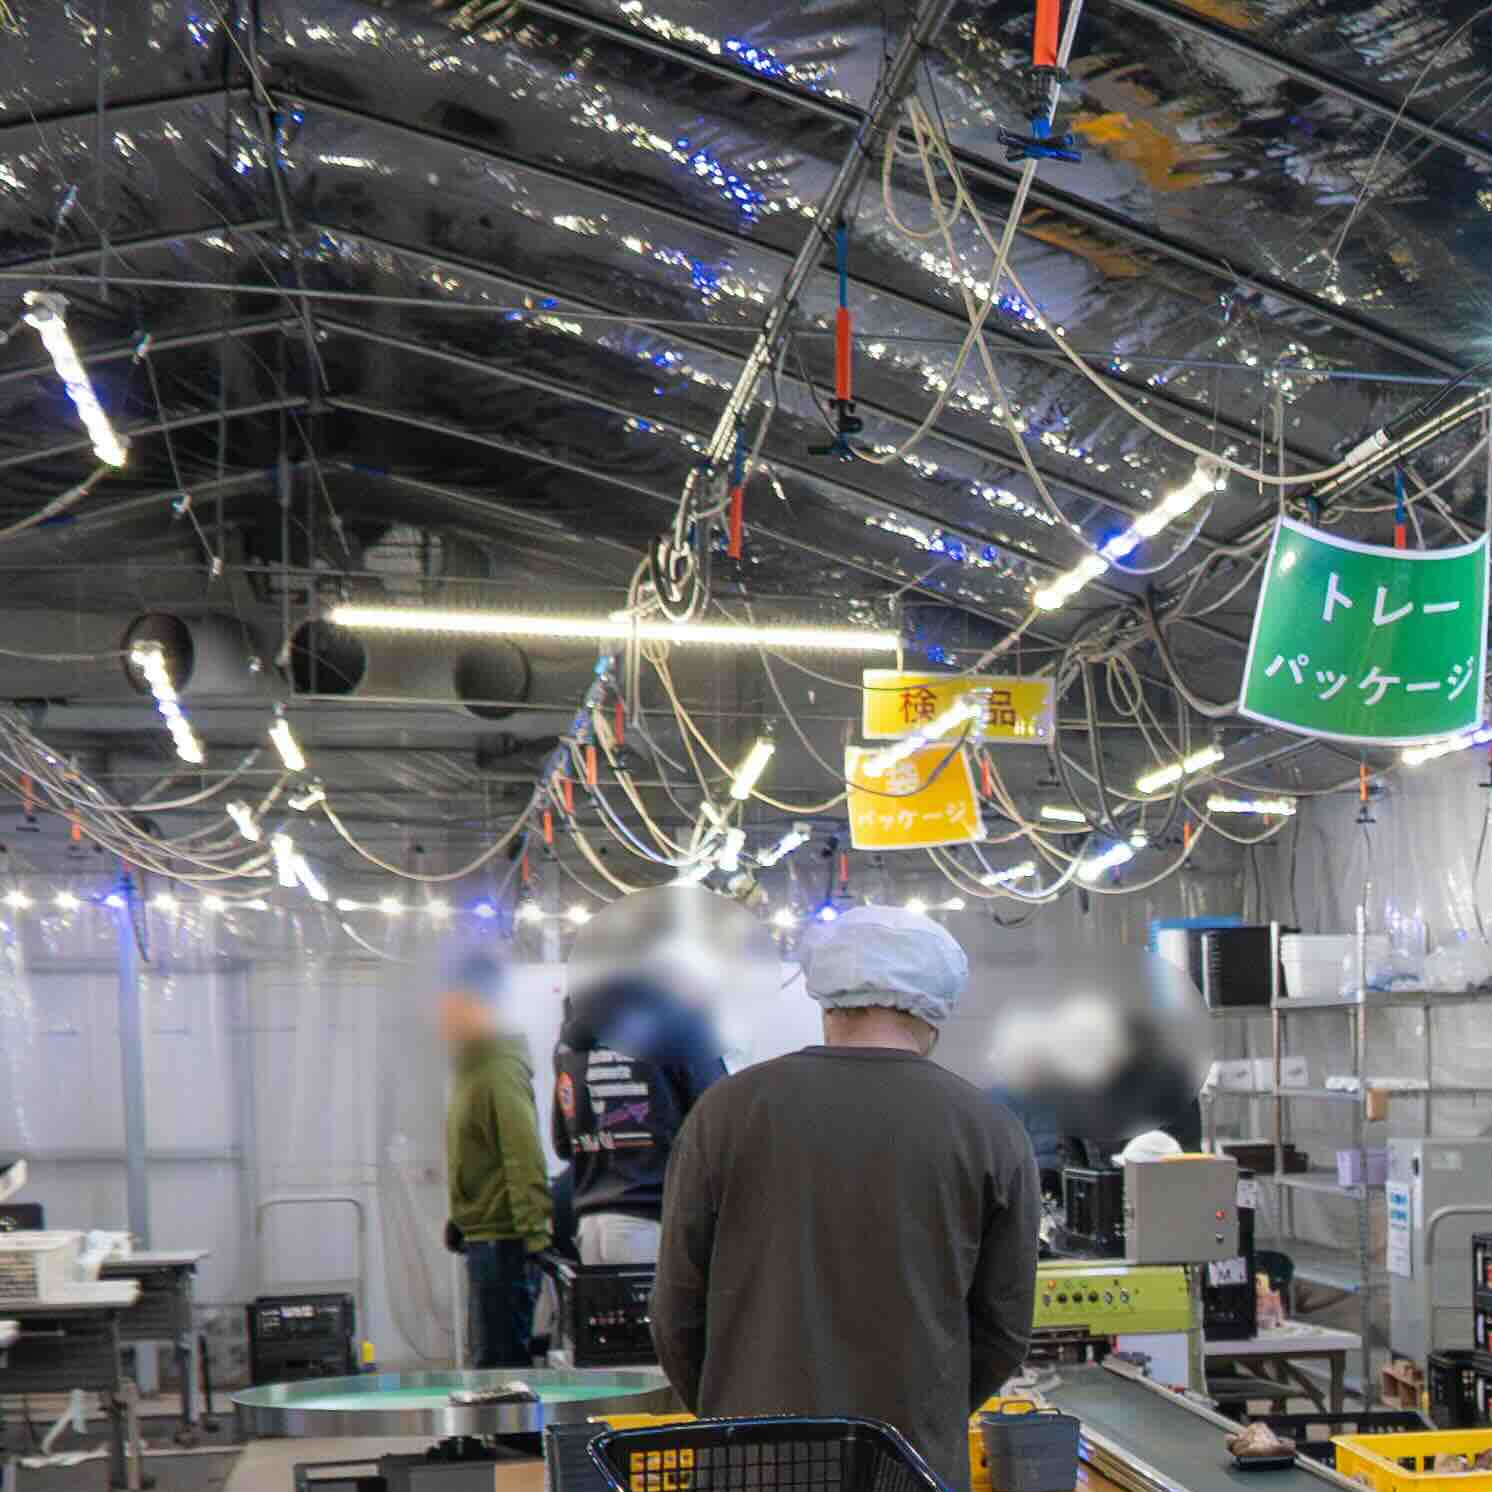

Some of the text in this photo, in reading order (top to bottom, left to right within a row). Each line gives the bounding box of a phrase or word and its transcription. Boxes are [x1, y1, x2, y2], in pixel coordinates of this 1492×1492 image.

[1321, 571, 1461, 627] トレー
[1264, 654, 1475, 706] パッケージ
